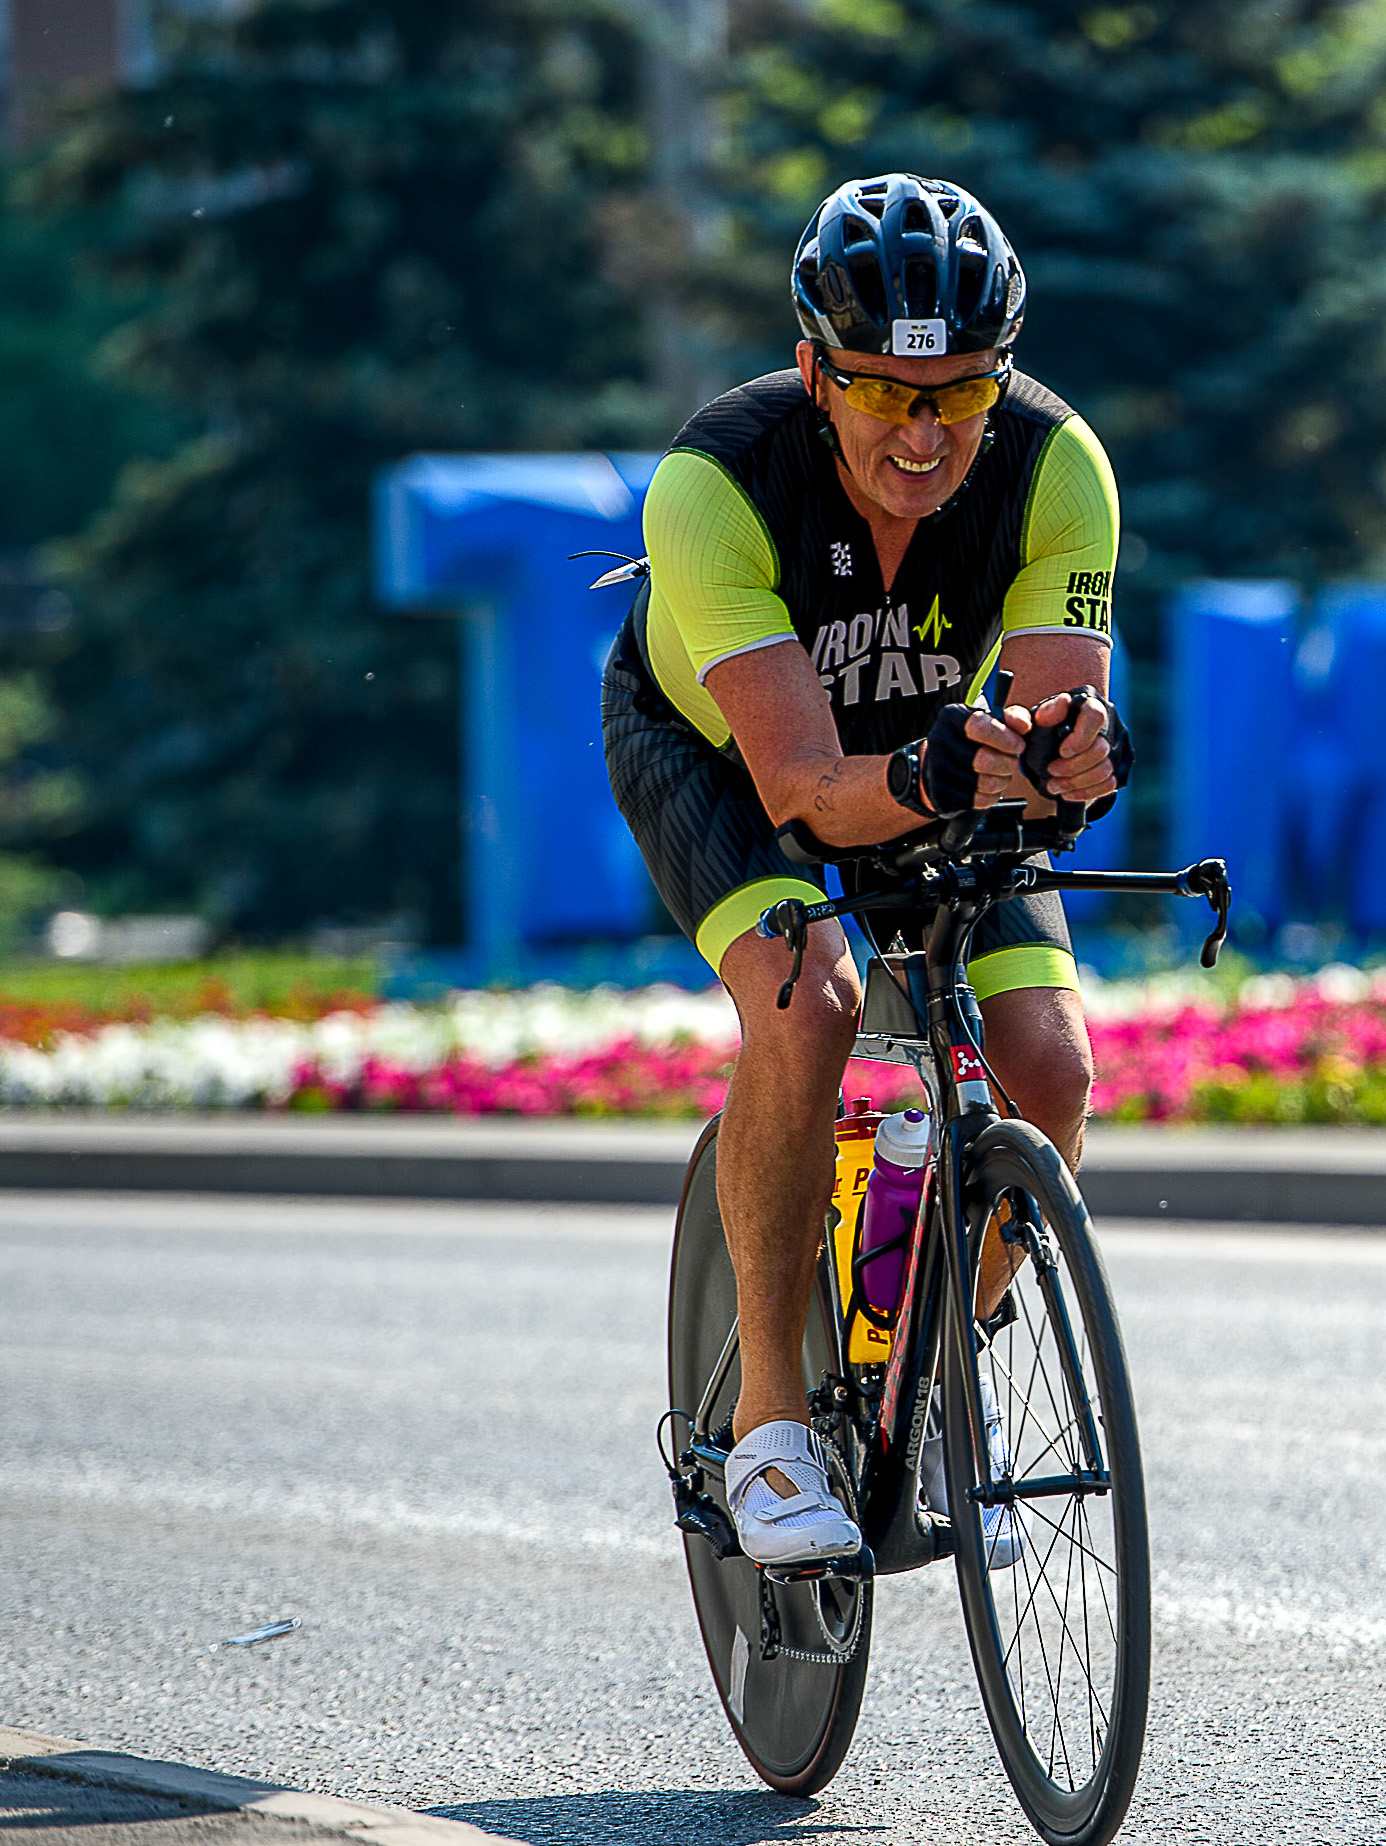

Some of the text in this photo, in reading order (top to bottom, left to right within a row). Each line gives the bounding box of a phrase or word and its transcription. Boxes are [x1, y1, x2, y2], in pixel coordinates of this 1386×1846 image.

[907, 333, 935, 349] 276
[1063, 596, 1109, 634] STA
[811, 603, 910, 672] IRON
